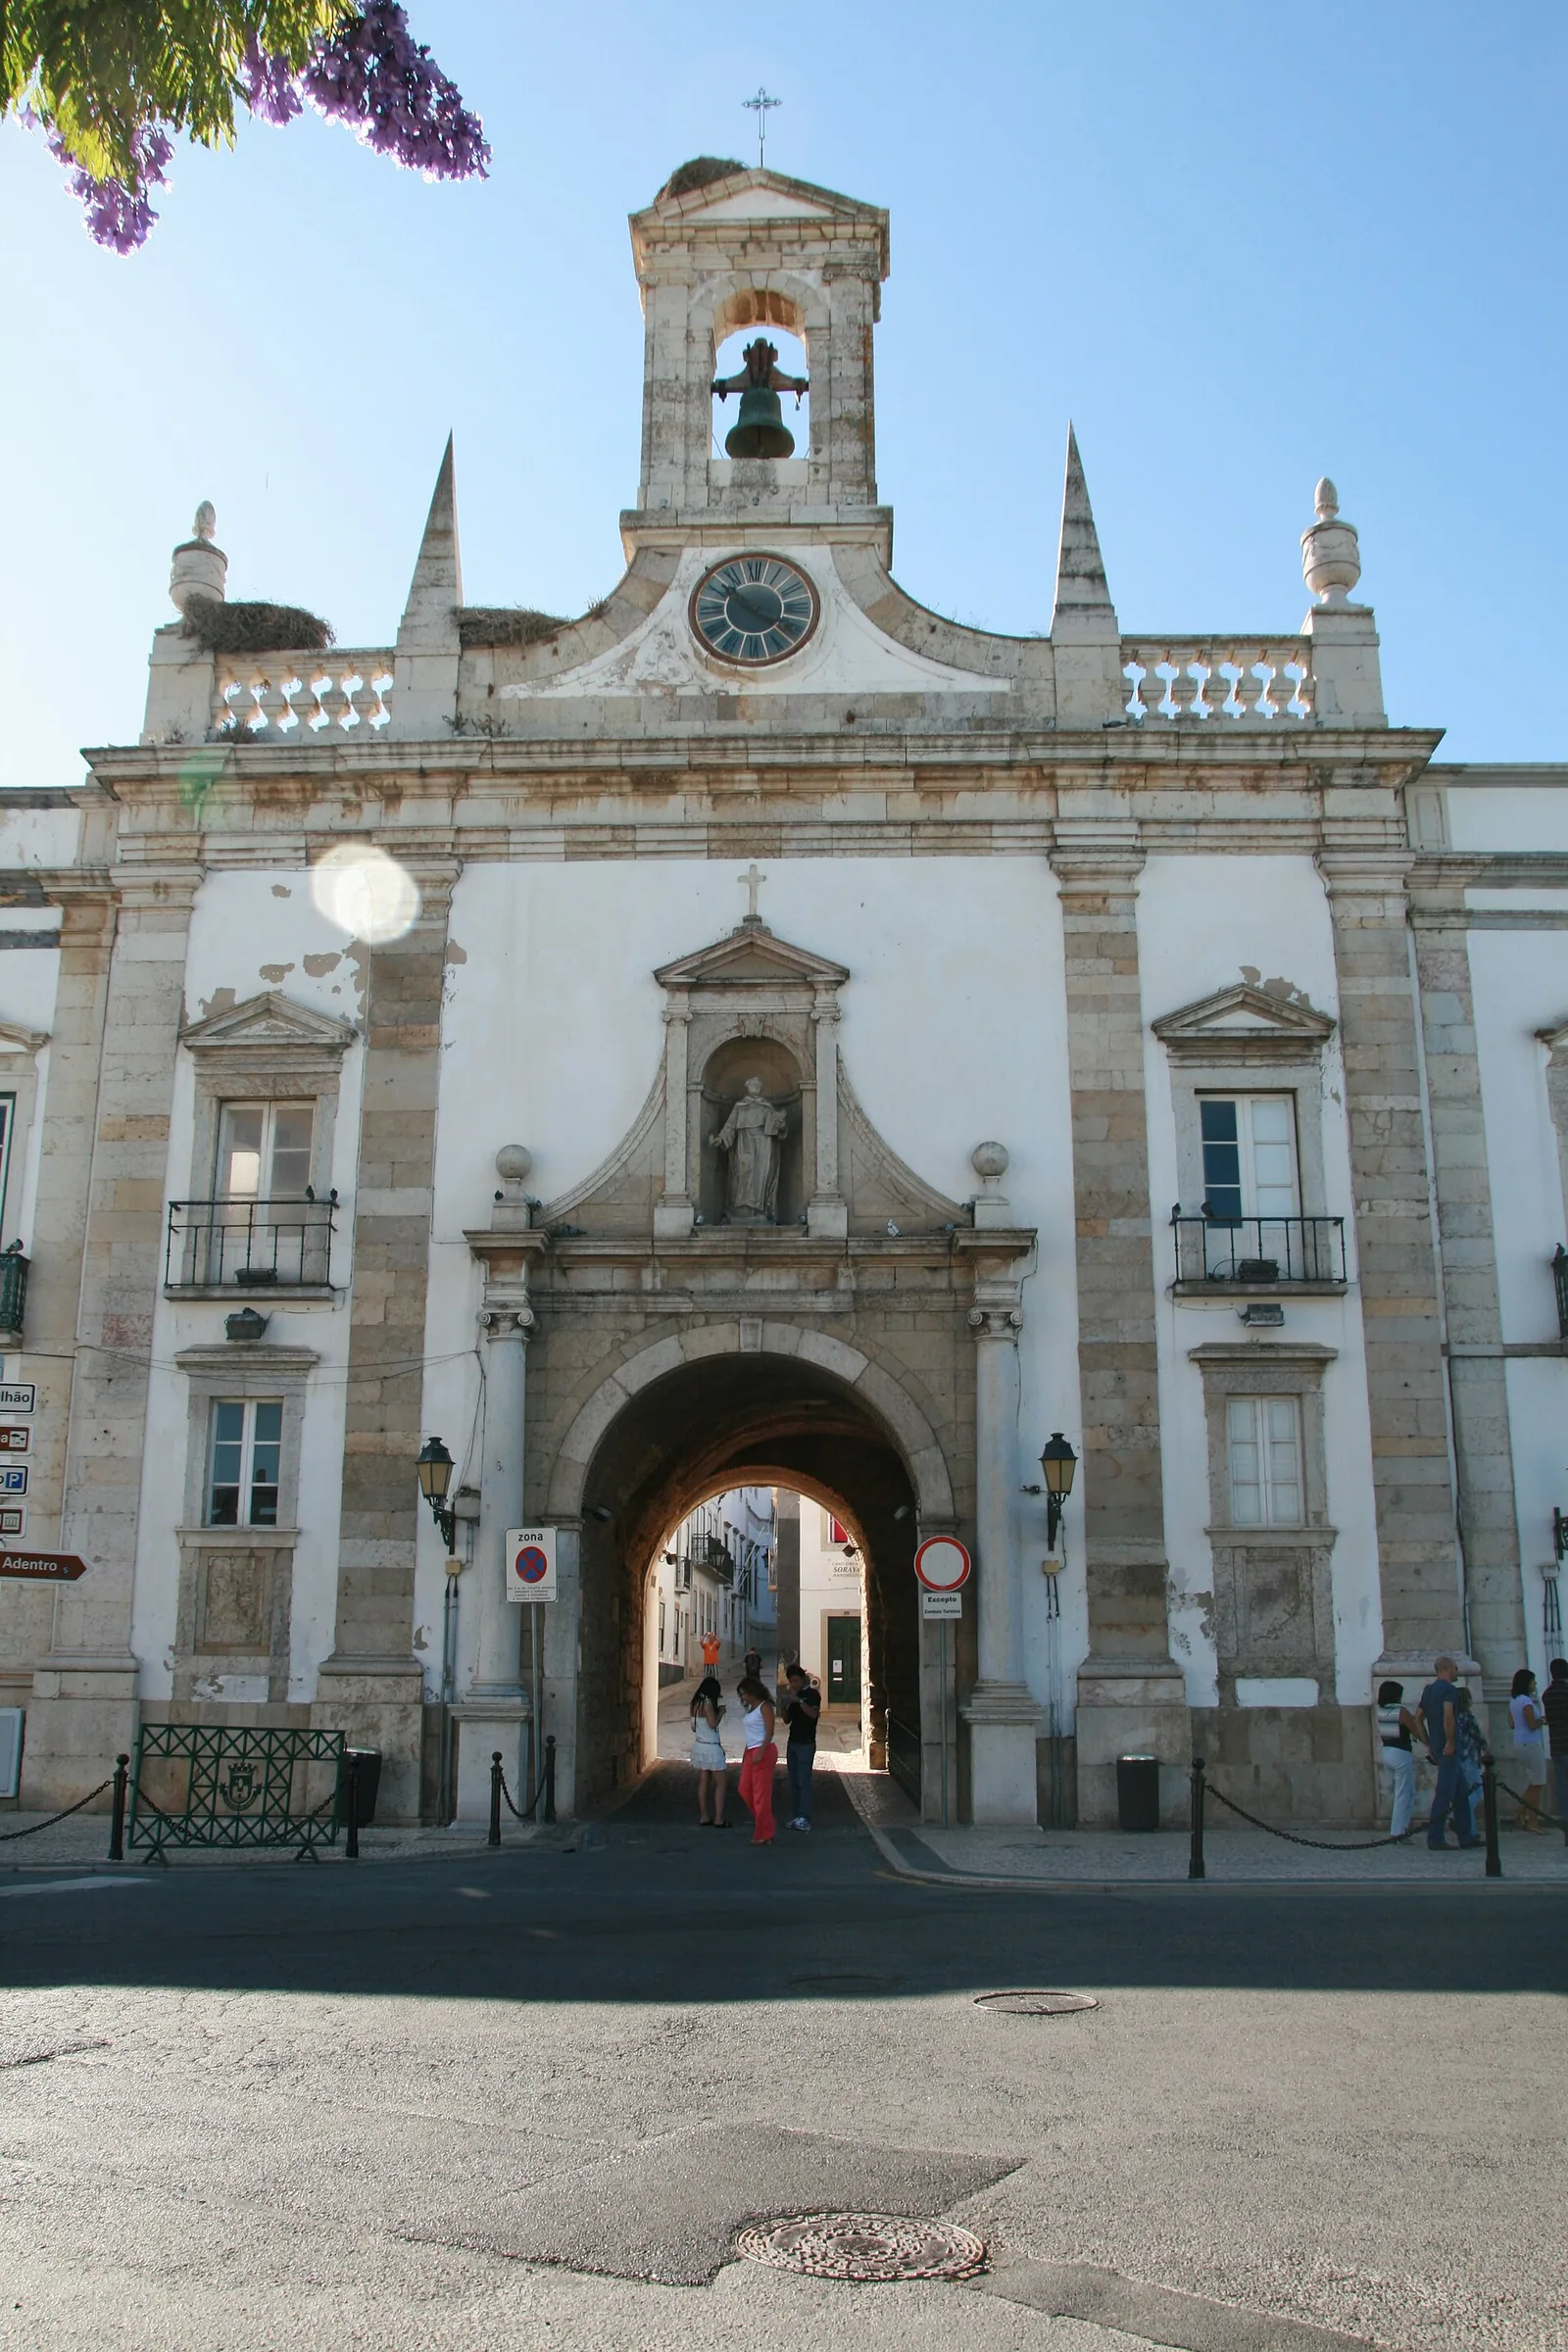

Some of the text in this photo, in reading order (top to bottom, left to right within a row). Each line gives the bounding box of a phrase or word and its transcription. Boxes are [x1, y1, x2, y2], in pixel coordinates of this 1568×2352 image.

[747, 561, 762, 581] XII
[517, 1533, 544, 1542] zona
[2, 1556, 58, 1571] Adentro
